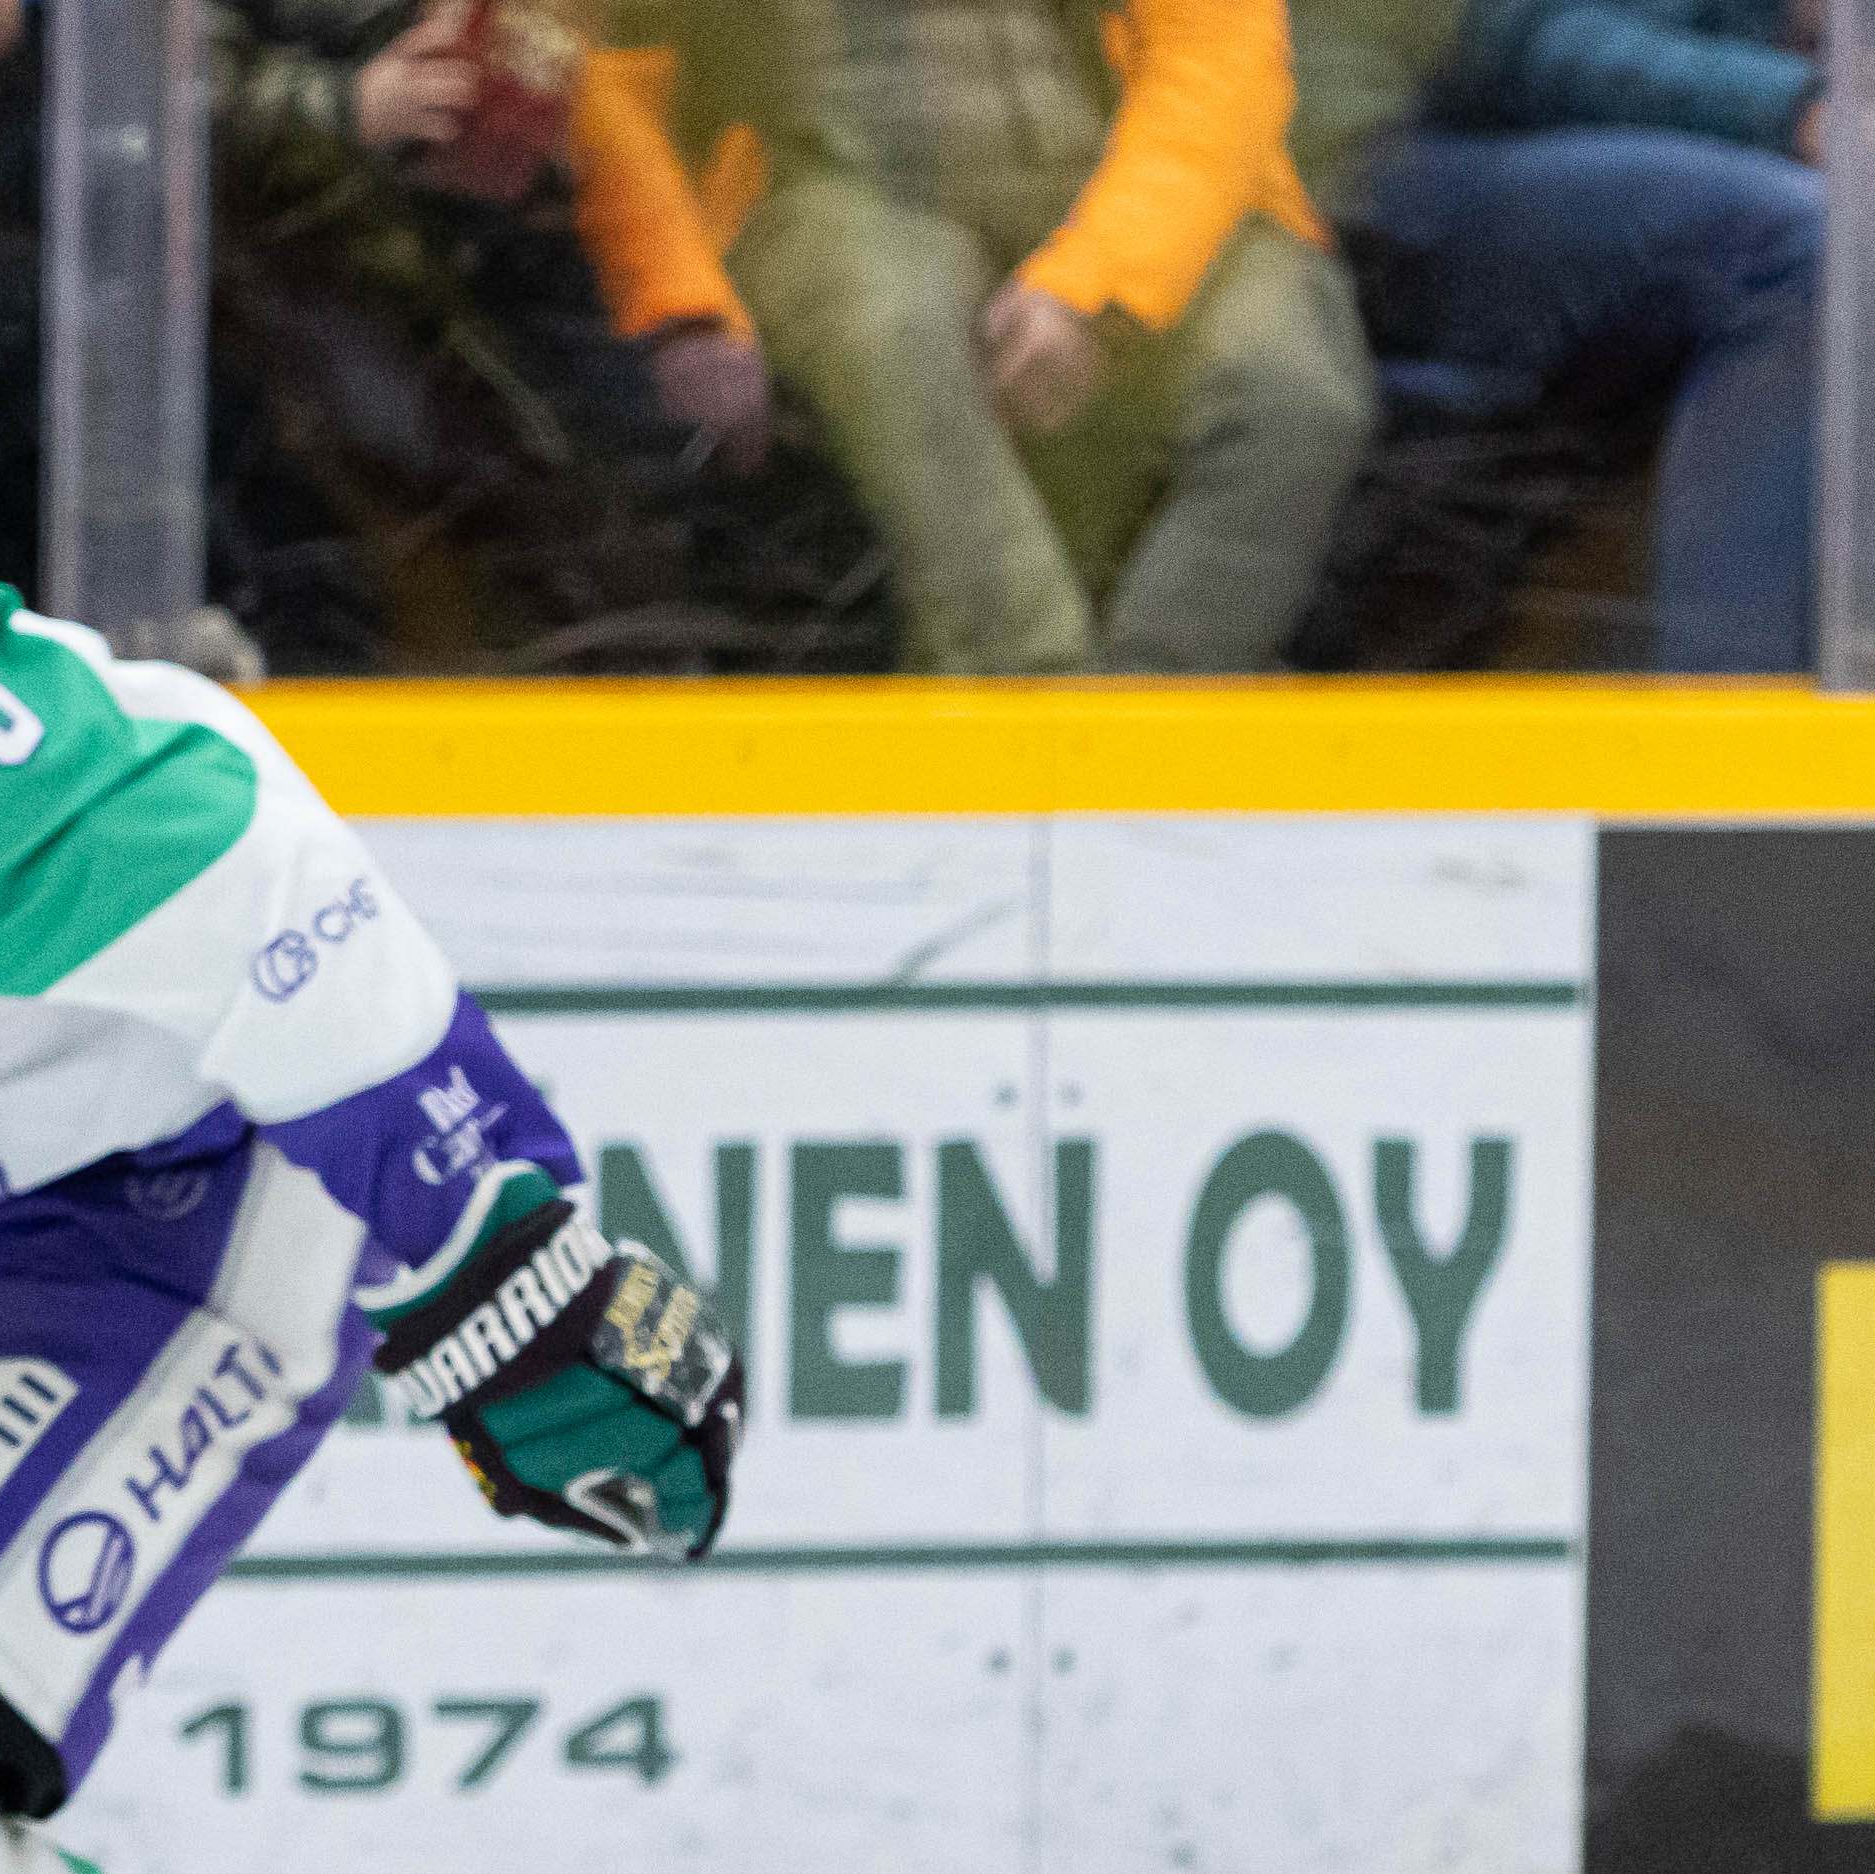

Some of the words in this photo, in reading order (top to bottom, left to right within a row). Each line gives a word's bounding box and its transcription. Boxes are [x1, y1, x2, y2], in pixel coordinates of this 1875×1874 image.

[1184, 1126, 1516, 1422] OY
[123, 1336, 284, 1522] HALTI
[177, 1691, 678, 1800] 1974
